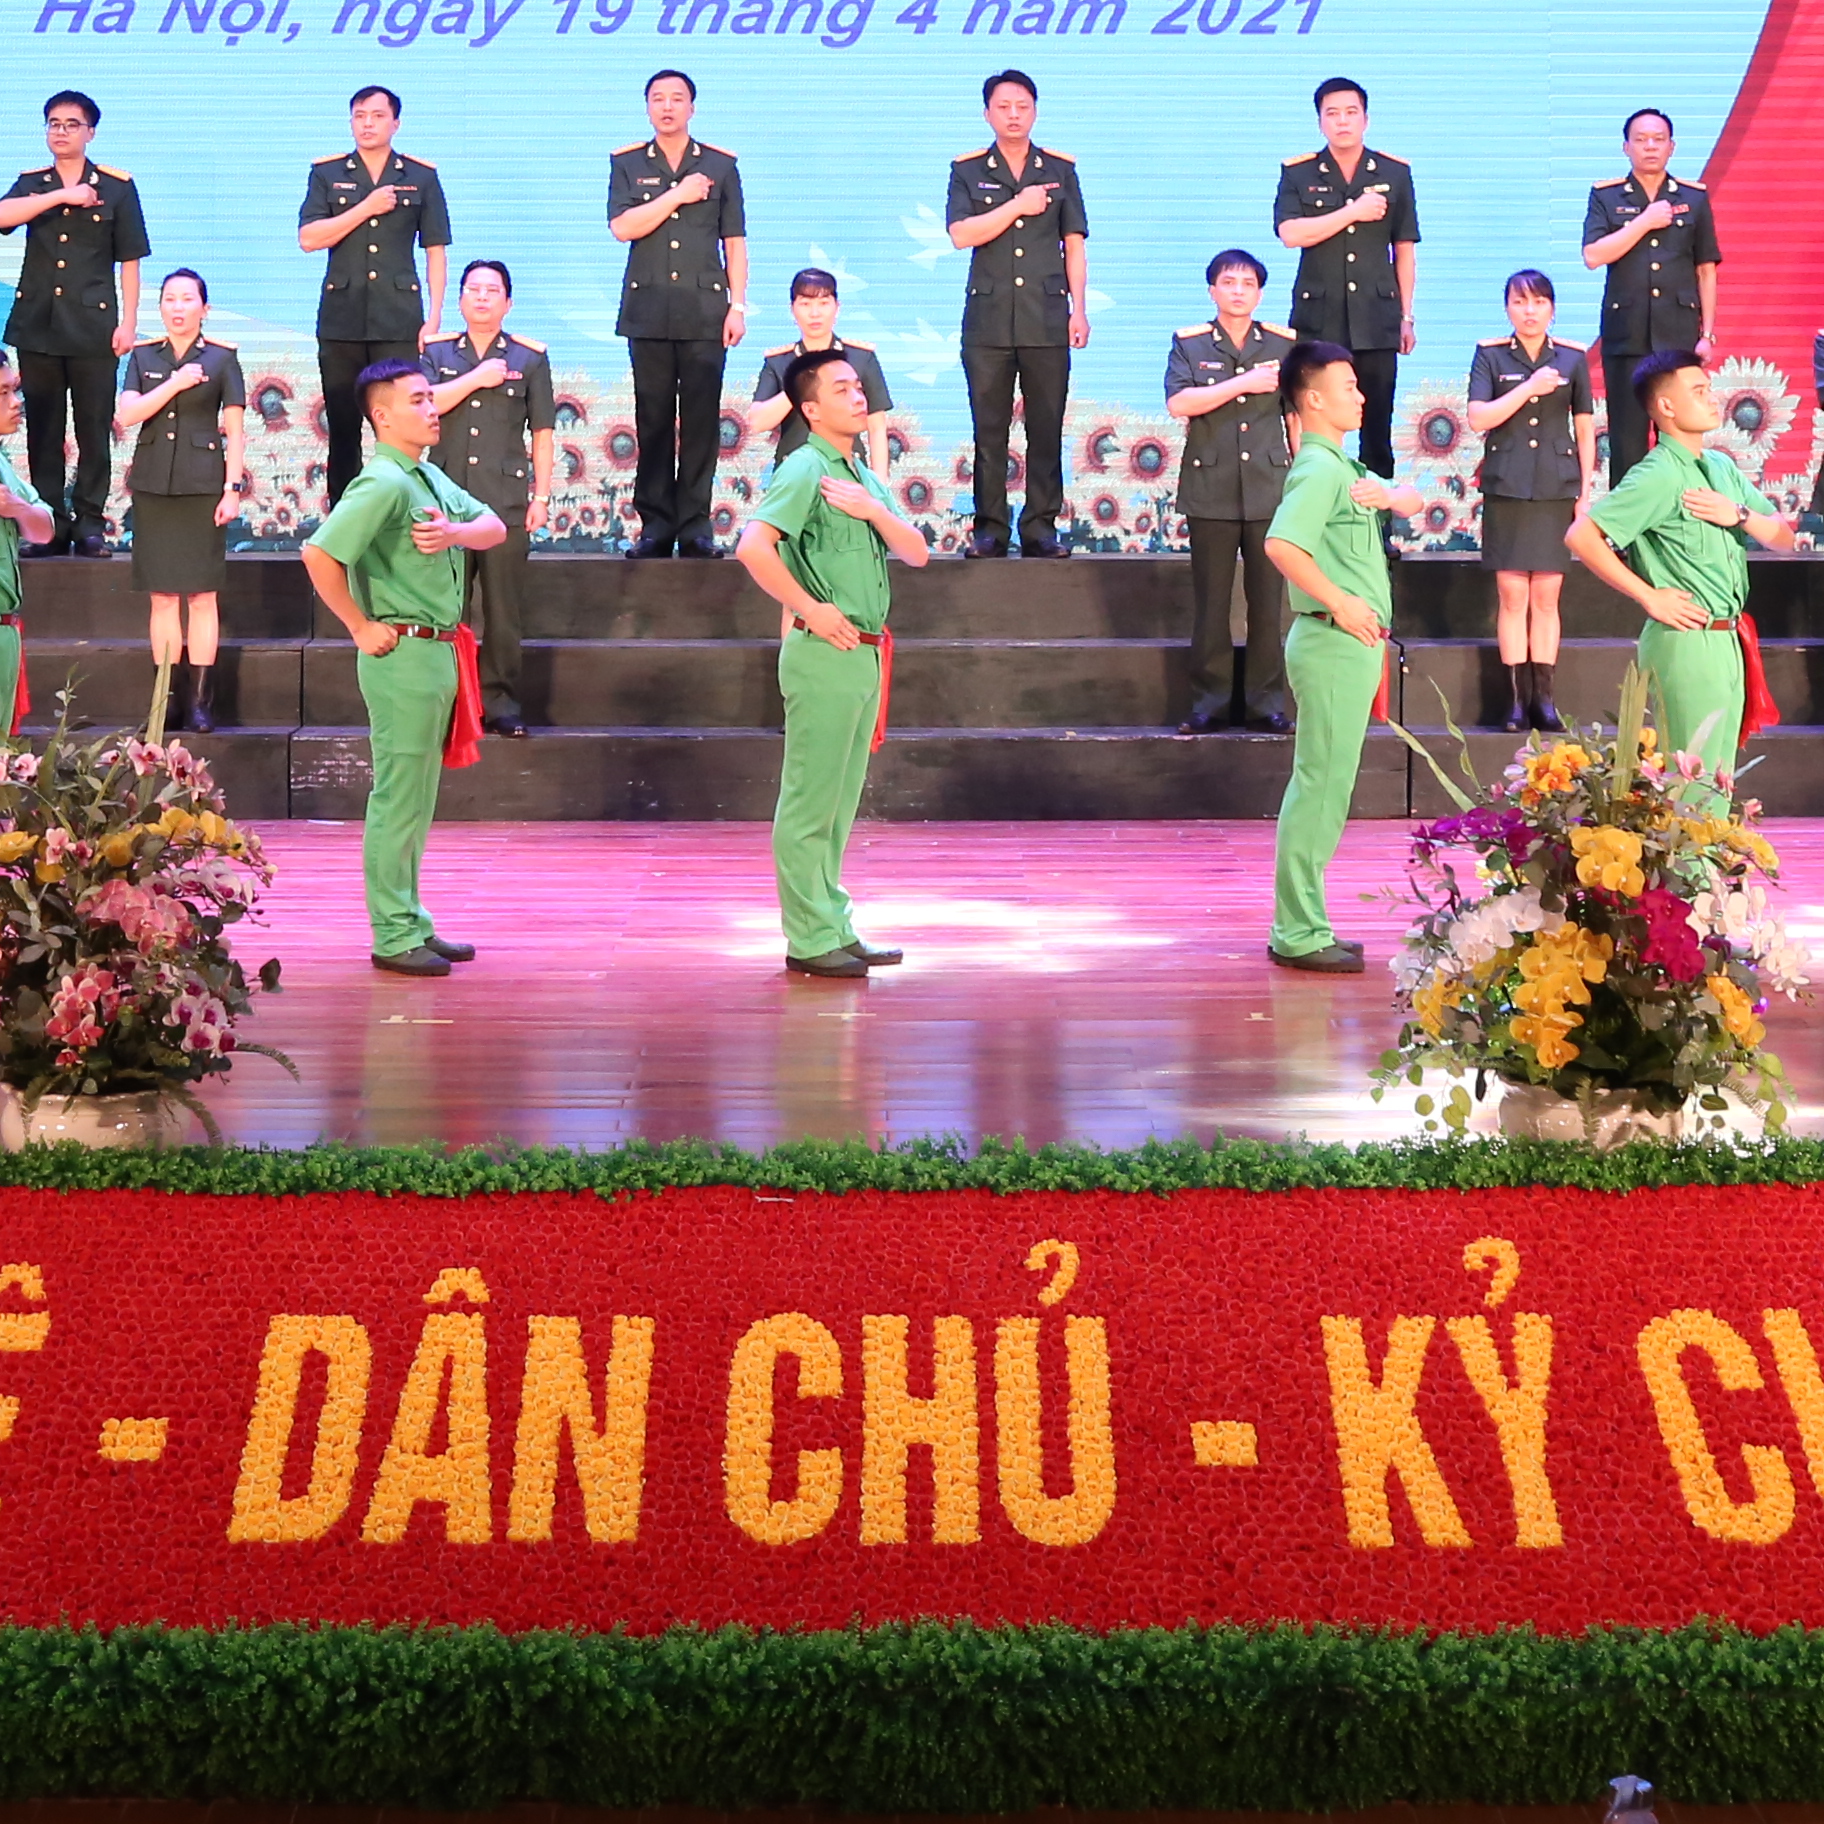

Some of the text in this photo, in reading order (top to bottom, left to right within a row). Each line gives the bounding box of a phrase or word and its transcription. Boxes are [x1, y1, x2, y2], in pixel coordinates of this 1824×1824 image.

[227, 1266, 656, 1544] DÂN
[722, 1238, 1118, 1545] CHỦ
[1320, 1236, 1564, 1548] KỶ
